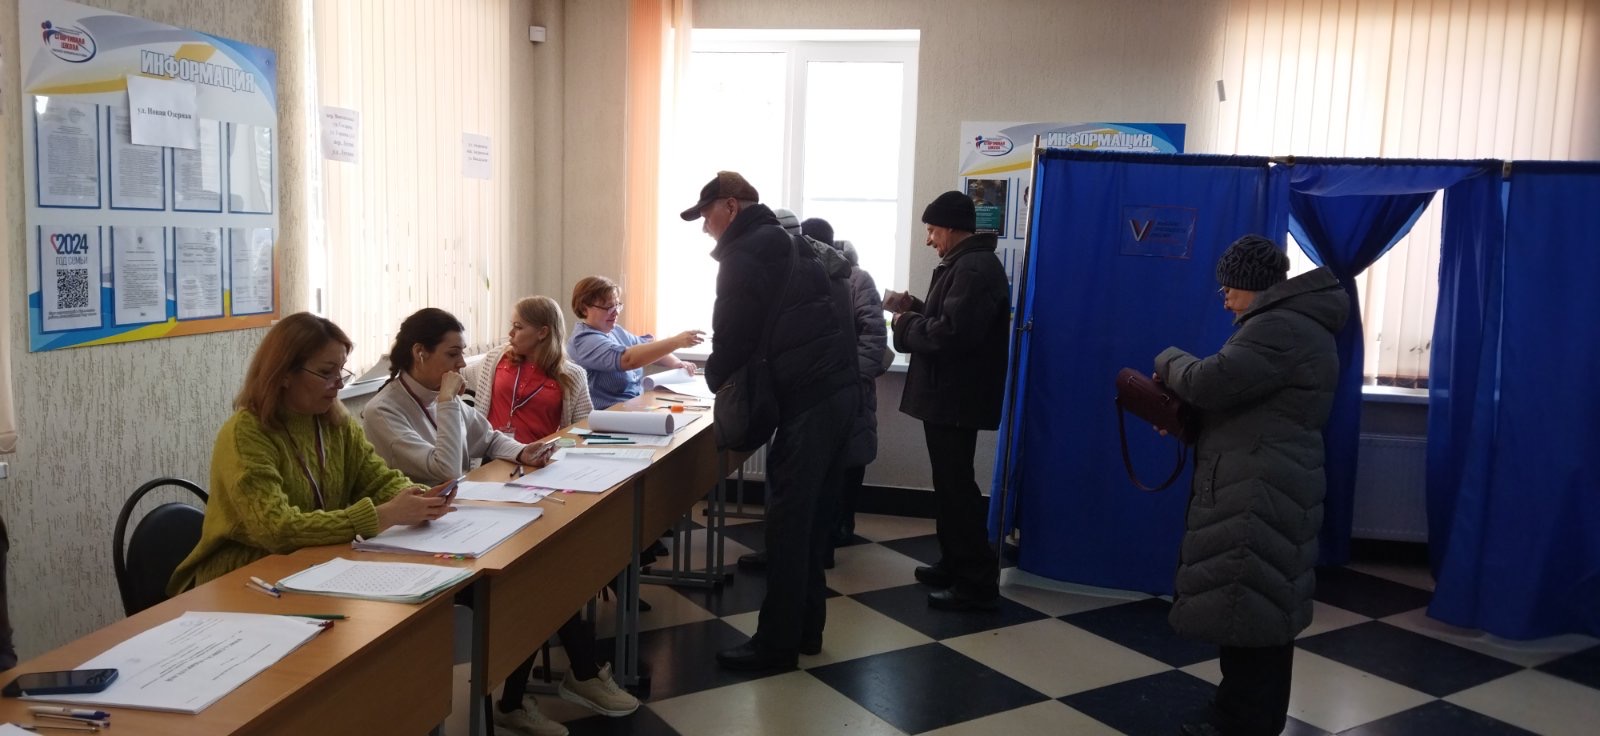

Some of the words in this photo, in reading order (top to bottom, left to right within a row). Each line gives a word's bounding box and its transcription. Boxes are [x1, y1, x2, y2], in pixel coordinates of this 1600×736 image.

[140, 49, 256, 93] ИНФОРМАЦИЯ
[1047, 132, 1153, 149] ИНФОРМАЦИЯ
[56, 233, 88, 254] 2024
